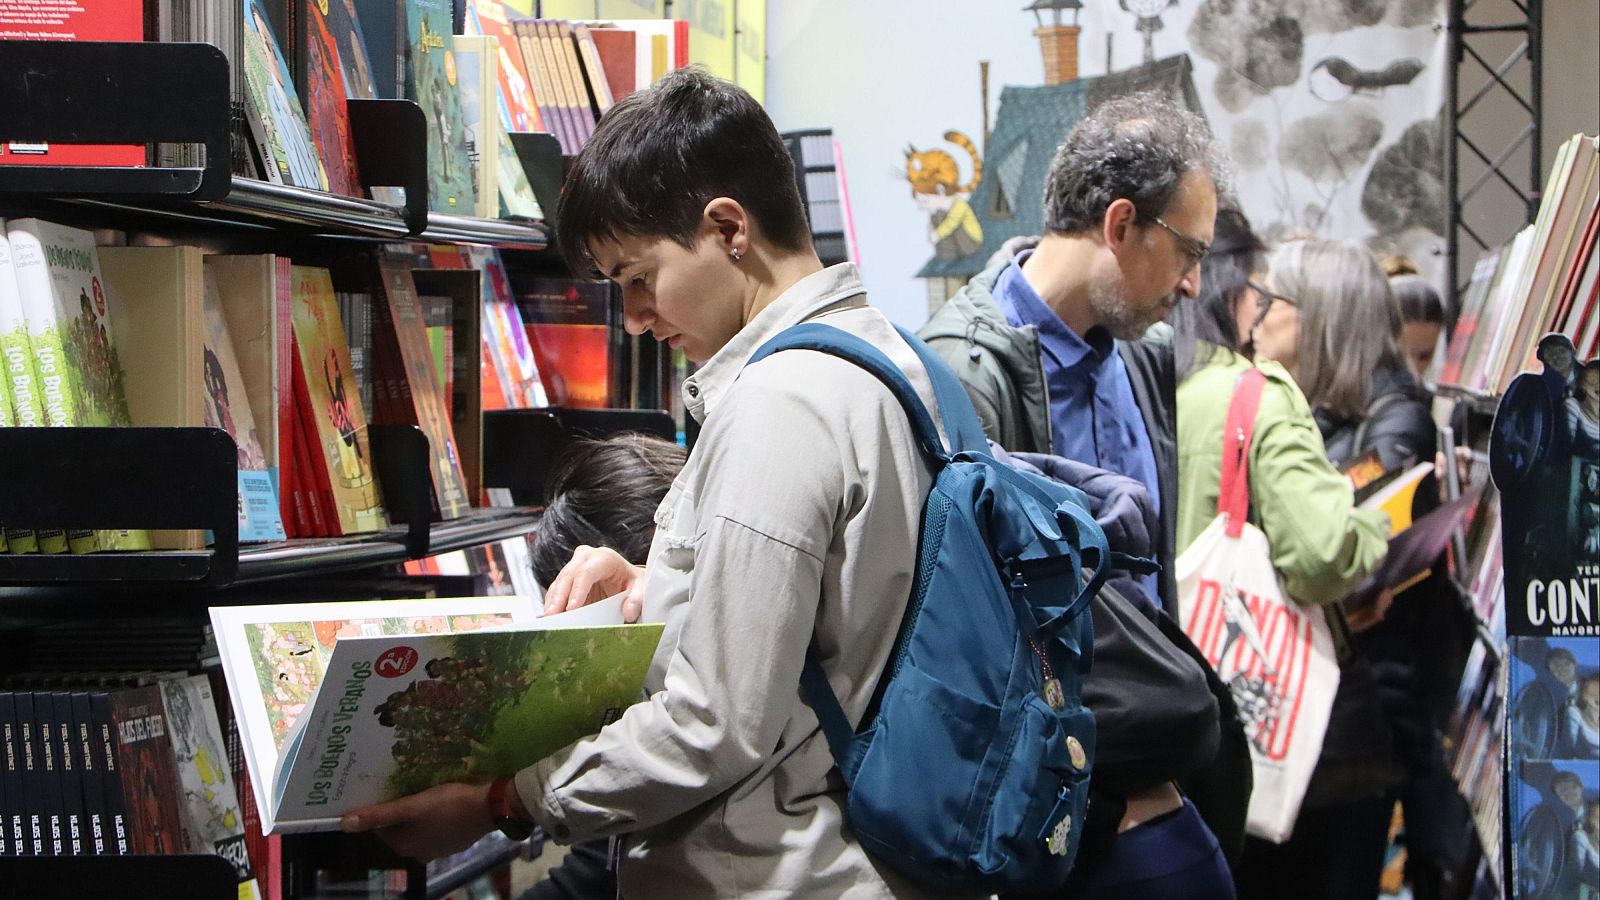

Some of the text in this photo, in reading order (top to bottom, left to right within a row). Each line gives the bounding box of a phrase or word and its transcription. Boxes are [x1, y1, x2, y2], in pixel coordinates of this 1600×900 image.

[5, 346, 24, 373] LOS
[36, 347, 56, 373] LOS
[333, 660, 373, 724] VERANOS
[312, 724, 352, 780] BUENOS
[305, 781, 332, 807] LOS
[13, 815, 24, 856] HIJOS DEL
[32, 815, 42, 856] HIJOS DEL
[51, 815, 62, 856] HIJOS DEL
[70, 815, 80, 856] HIJOS DEL
[92, 815, 104, 856] HIJOS DEL
[115, 815, 127, 856] HIJOS DEL
